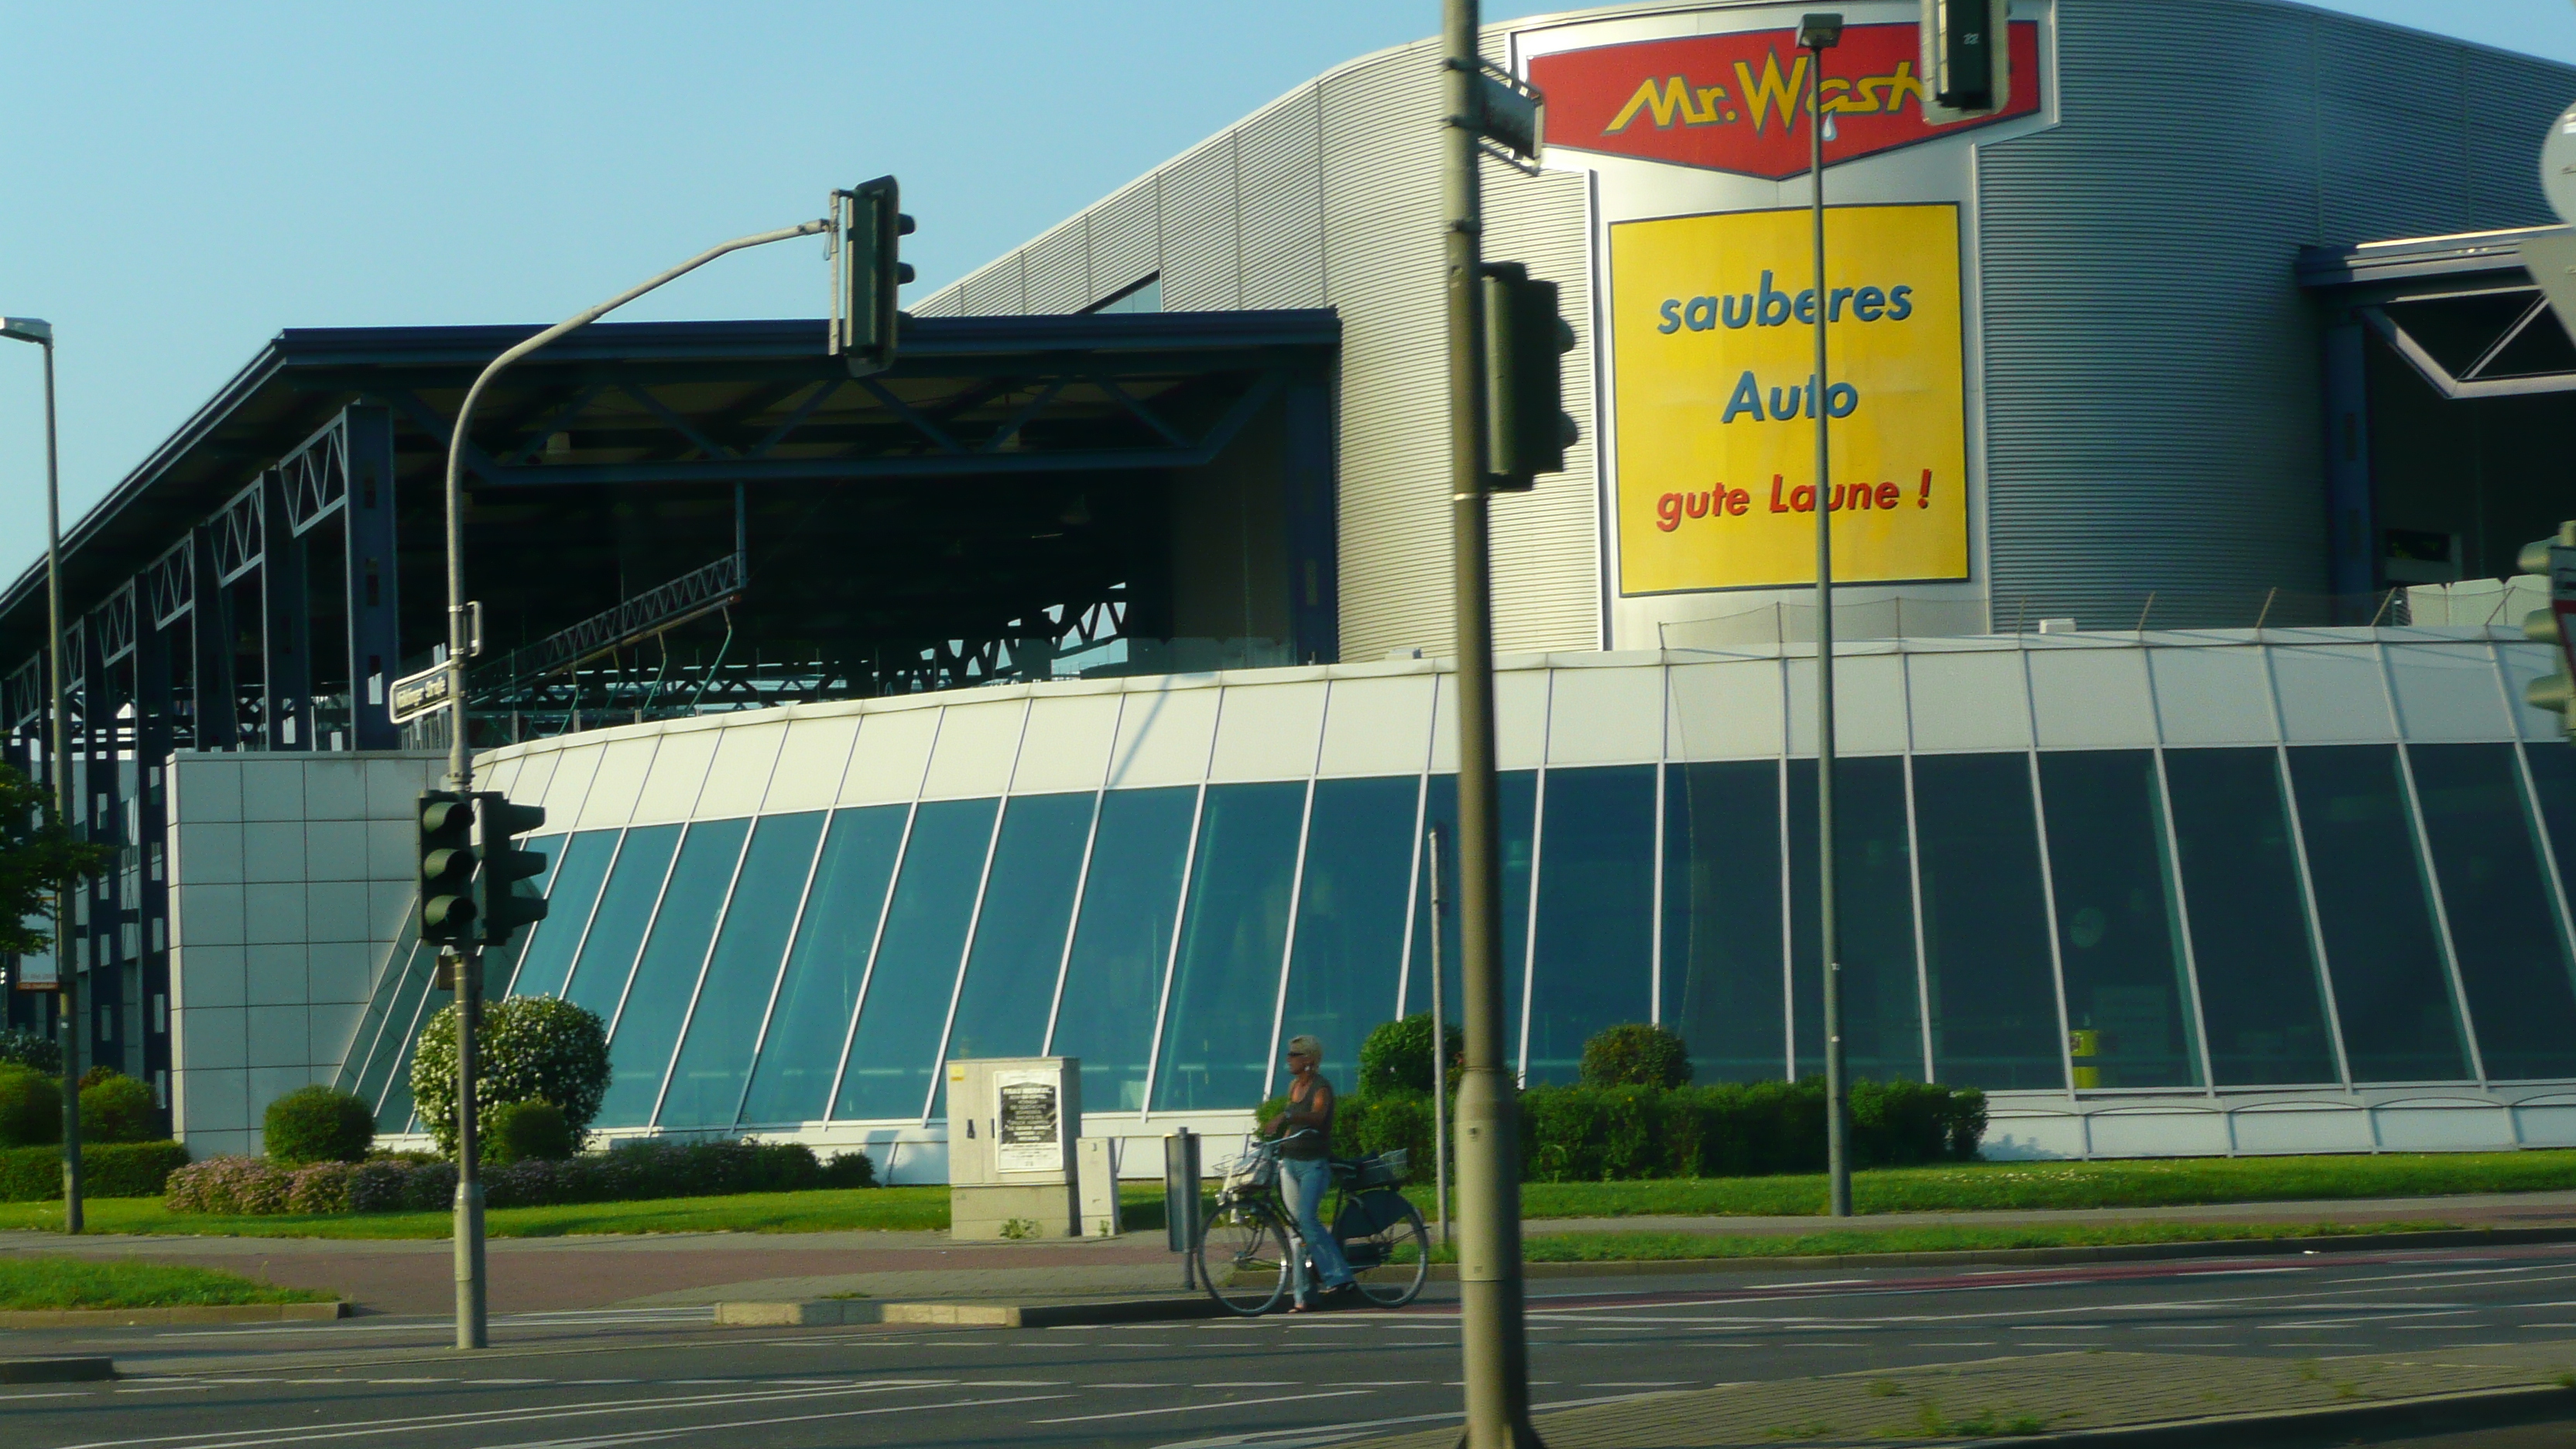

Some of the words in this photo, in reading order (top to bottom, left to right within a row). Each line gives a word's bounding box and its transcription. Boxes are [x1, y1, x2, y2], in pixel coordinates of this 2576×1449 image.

[1605, 76, 1737, 134] Mr.
[1657, 270, 1913, 334] sauberes
[1721, 371, 1858, 423] Auto
[1656, 482, 1750, 532] gute
[1769, 474, 1899, 513] Laune
[1917, 468, 1932, 509] !
